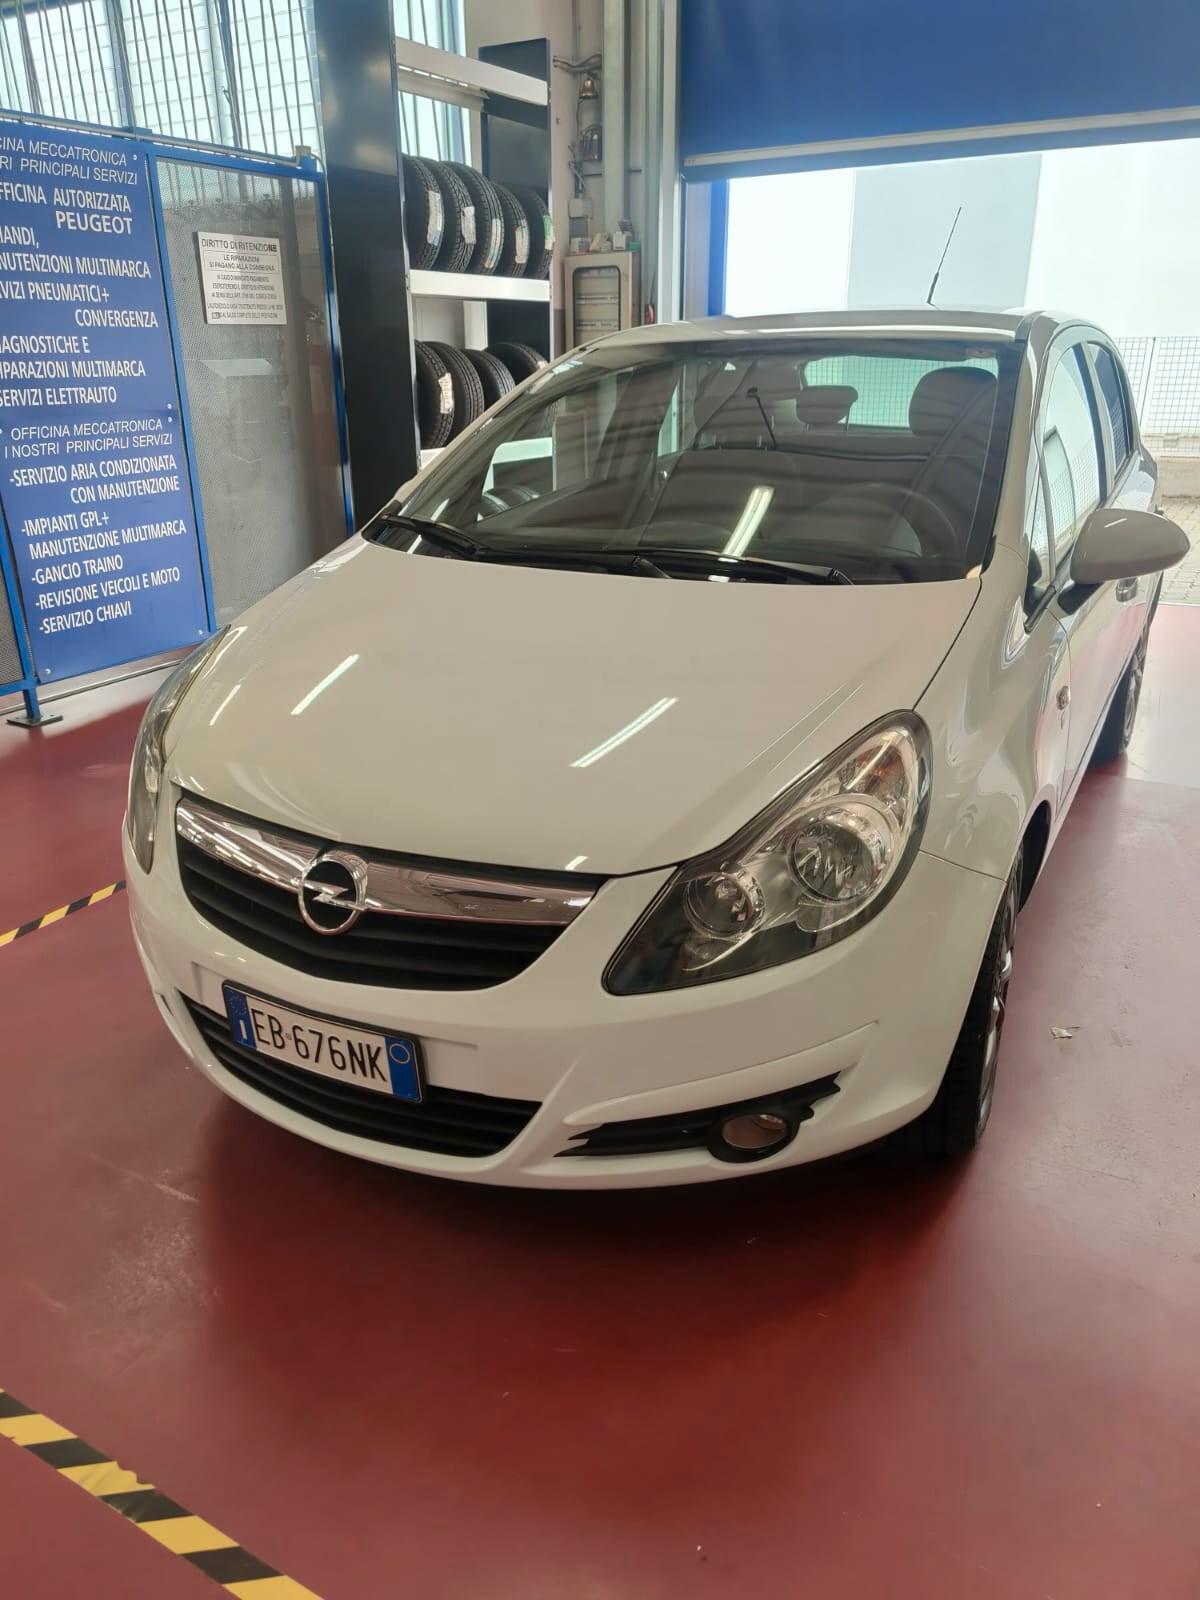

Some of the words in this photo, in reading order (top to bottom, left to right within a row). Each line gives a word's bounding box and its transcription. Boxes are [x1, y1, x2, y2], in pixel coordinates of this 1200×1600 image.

[29, 140, 127, 166] MECCATRONICA
[20, 158, 90, 179] PRINCIPALI
[93, 168, 137, 185] SERVIZI
[54, 188, 131, 213] AUTORIZZATA
[55, 210, 132, 235] PEUGEOT
[202, 239, 228, 249] DIRITTO
[75, 257, 152, 278] MULTIMARCA
[0, 281, 25, 300] VIZI
[75, 309, 158, 328] CONVERGENZA
[0, 335, 80, 354] AGNOSTICHE
[82, 336, 90, 354] E
[72, 360, 146, 378] MULTIMARCA
[45, 386, 117, 405] ELETTRAUTO
[11, 425, 70, 441] OFFICINA
[73, 418, 163, 437] MECCATRONICA
[4, 446, 8, 458] I
[12, 442, 60, 458] NOSTRI
[66, 437, 129, 454] PRINCIPALI
[132, 433, 173, 448] SERVIZI
[9, 465, 67, 487] -SERVIZIO
[71, 462, 98, 481] ARIA
[99, 454, 177, 477] CONDIZIONATA
[70, 487, 96, 504] CON
[98, 476, 180, 501] MANUTENZIONE
[21, 514, 78, 537] -IMPIANTI
[29, 530, 119, 560] MANUTENZIONE
[121, 519, 187, 544] MULTIMARCA
[31, 562, 81, 585] -GANCIO
[83, 554, 123, 576] TRAINO
[35, 583, 99, 610] -REVISIONE
[100, 575, 141, 597] VEICOLI
[143, 573, 150, 588] E
[150, 567, 180, 587] MOTO
[39, 609, 93, 634] -SERVIZIO
[96, 601, 132, 622] CHIAVI
